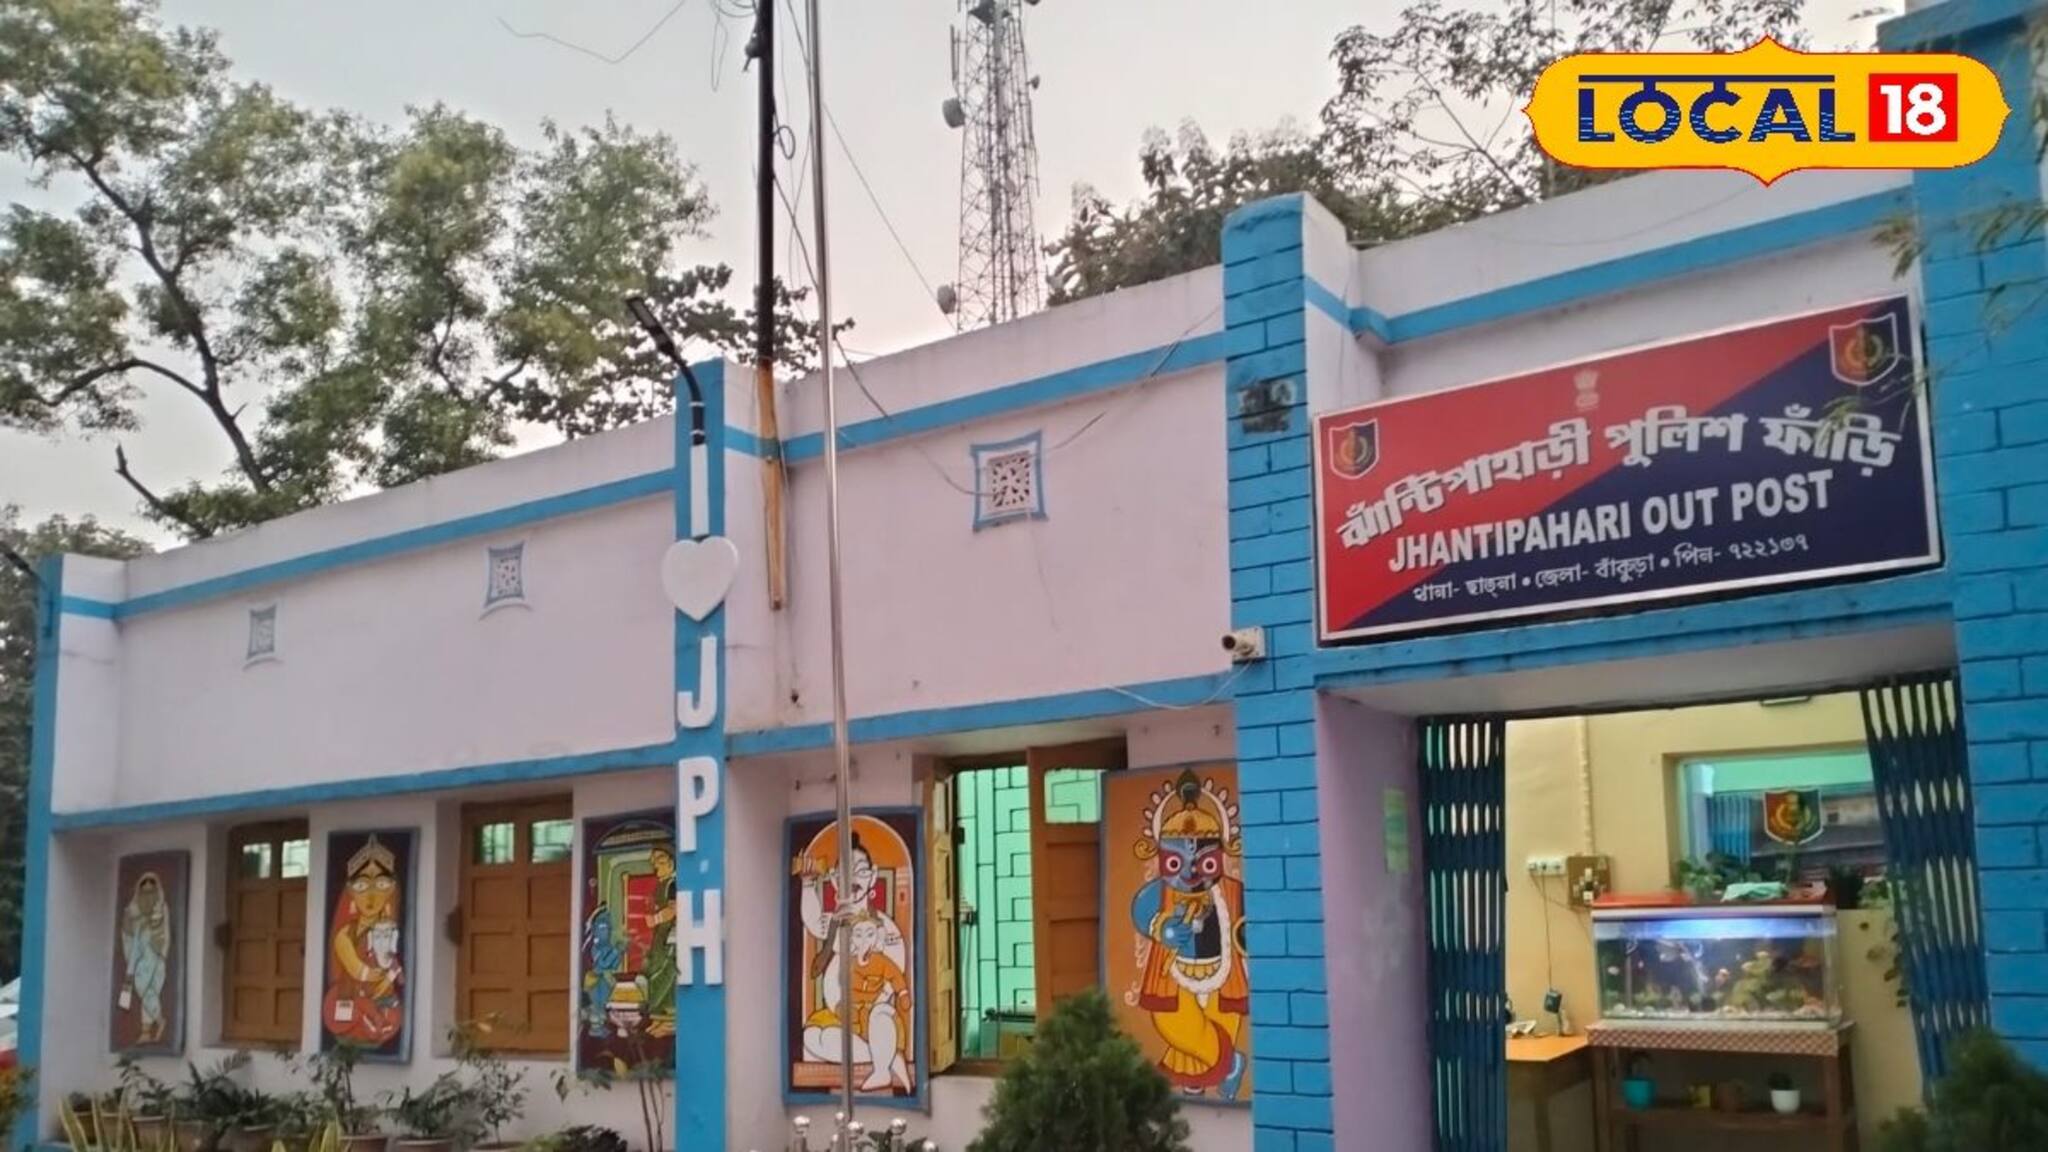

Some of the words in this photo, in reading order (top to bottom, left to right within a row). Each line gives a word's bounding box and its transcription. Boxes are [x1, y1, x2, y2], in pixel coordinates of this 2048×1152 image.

[1604, 405, 1748, 467] পুলিশ
[1759, 403, 1903, 477] ফাঁড়ি
[1388, 501, 1632, 573] JHANTIPAHARI
[1642, 486, 1720, 535] OUT
[1730, 468, 1834, 524] POST
[1728, 533, 1810, 560] ৭২২১৩৭
